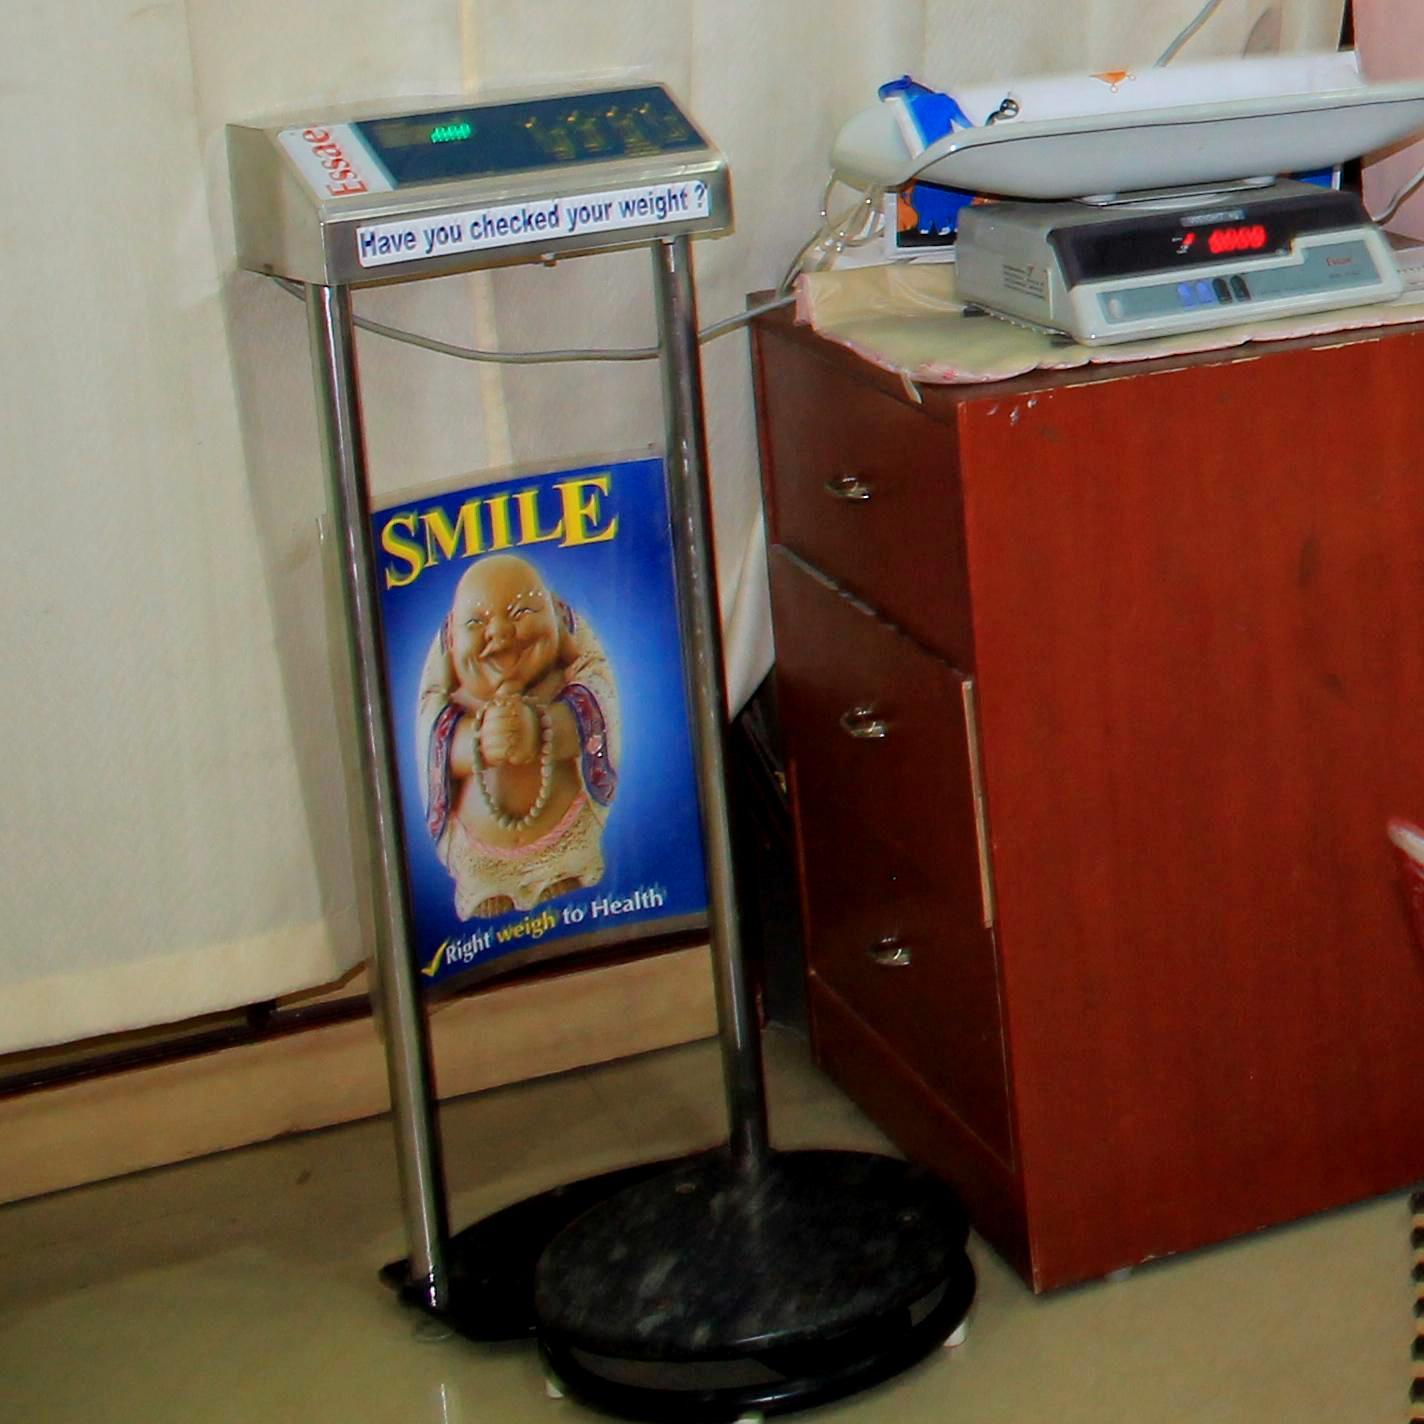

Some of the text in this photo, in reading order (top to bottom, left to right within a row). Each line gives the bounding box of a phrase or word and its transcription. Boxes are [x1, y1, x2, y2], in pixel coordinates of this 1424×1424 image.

[302, 125, 369, 197] Essae
[360, 231, 417, 259] Have
[424, 226, 463, 255] you
[470, 204, 560, 242] checked
[567, 201, 613, 234] your
[618, 188, 689, 222] weight
[380, 474, 619, 591] SMILE
[445, 887, 664, 966] Right weigh to Health
